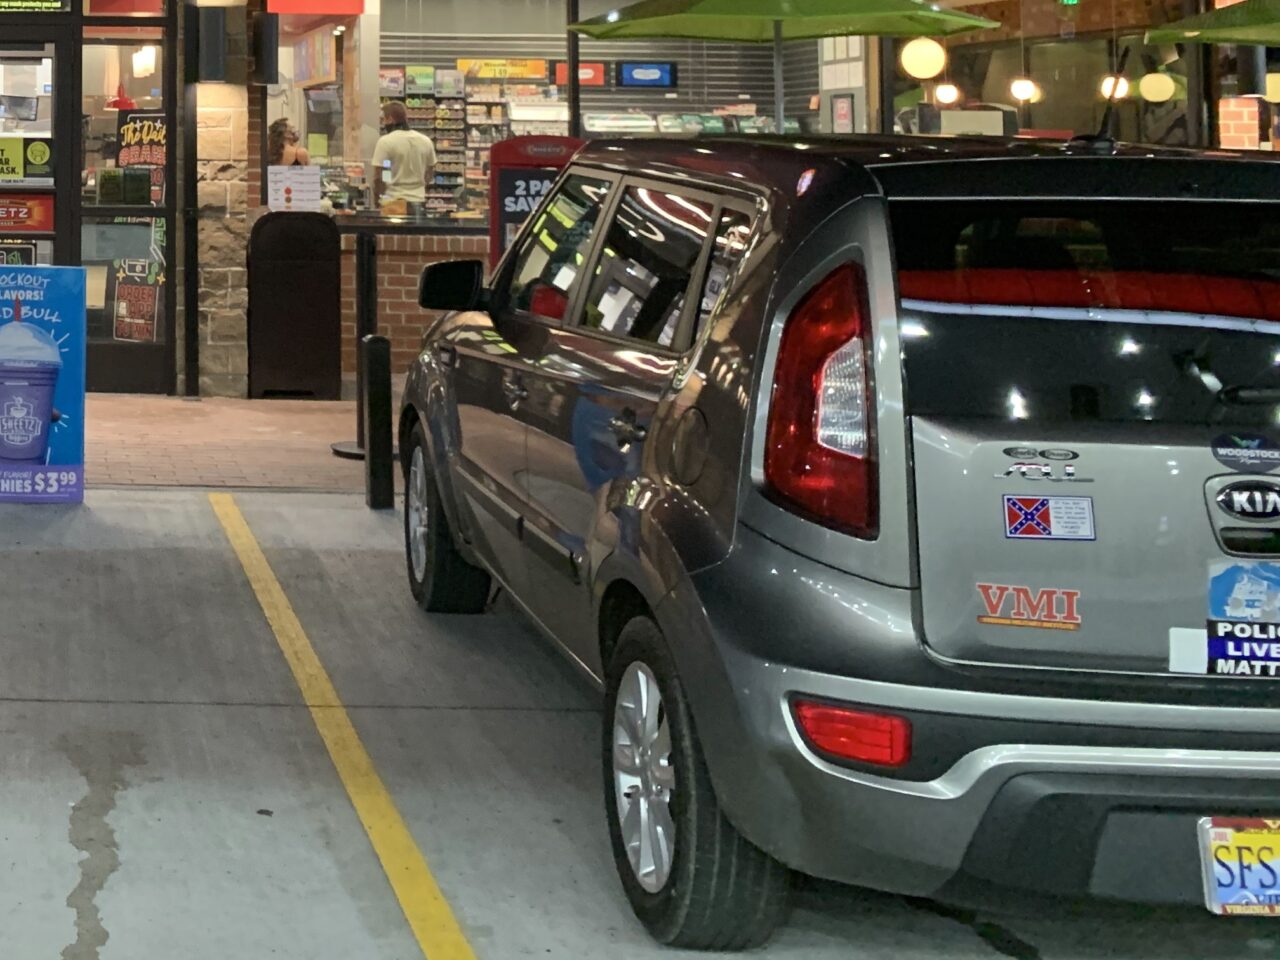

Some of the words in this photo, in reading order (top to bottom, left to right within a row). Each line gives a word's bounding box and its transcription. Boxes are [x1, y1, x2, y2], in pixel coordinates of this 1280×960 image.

[515, 179, 527, 195] 2
[529, 179, 553, 195] PA
[504, 196, 542, 212] SAV
[21, 306, 62, 322] BULL
[2, 418, 35, 432] SHEETZ
[1232, 491, 1280, 512] KIA
[976, 582, 1081, 623] VMI
[1217, 623, 1280, 639] POLI
[1214, 845, 1277, 889] SFS
